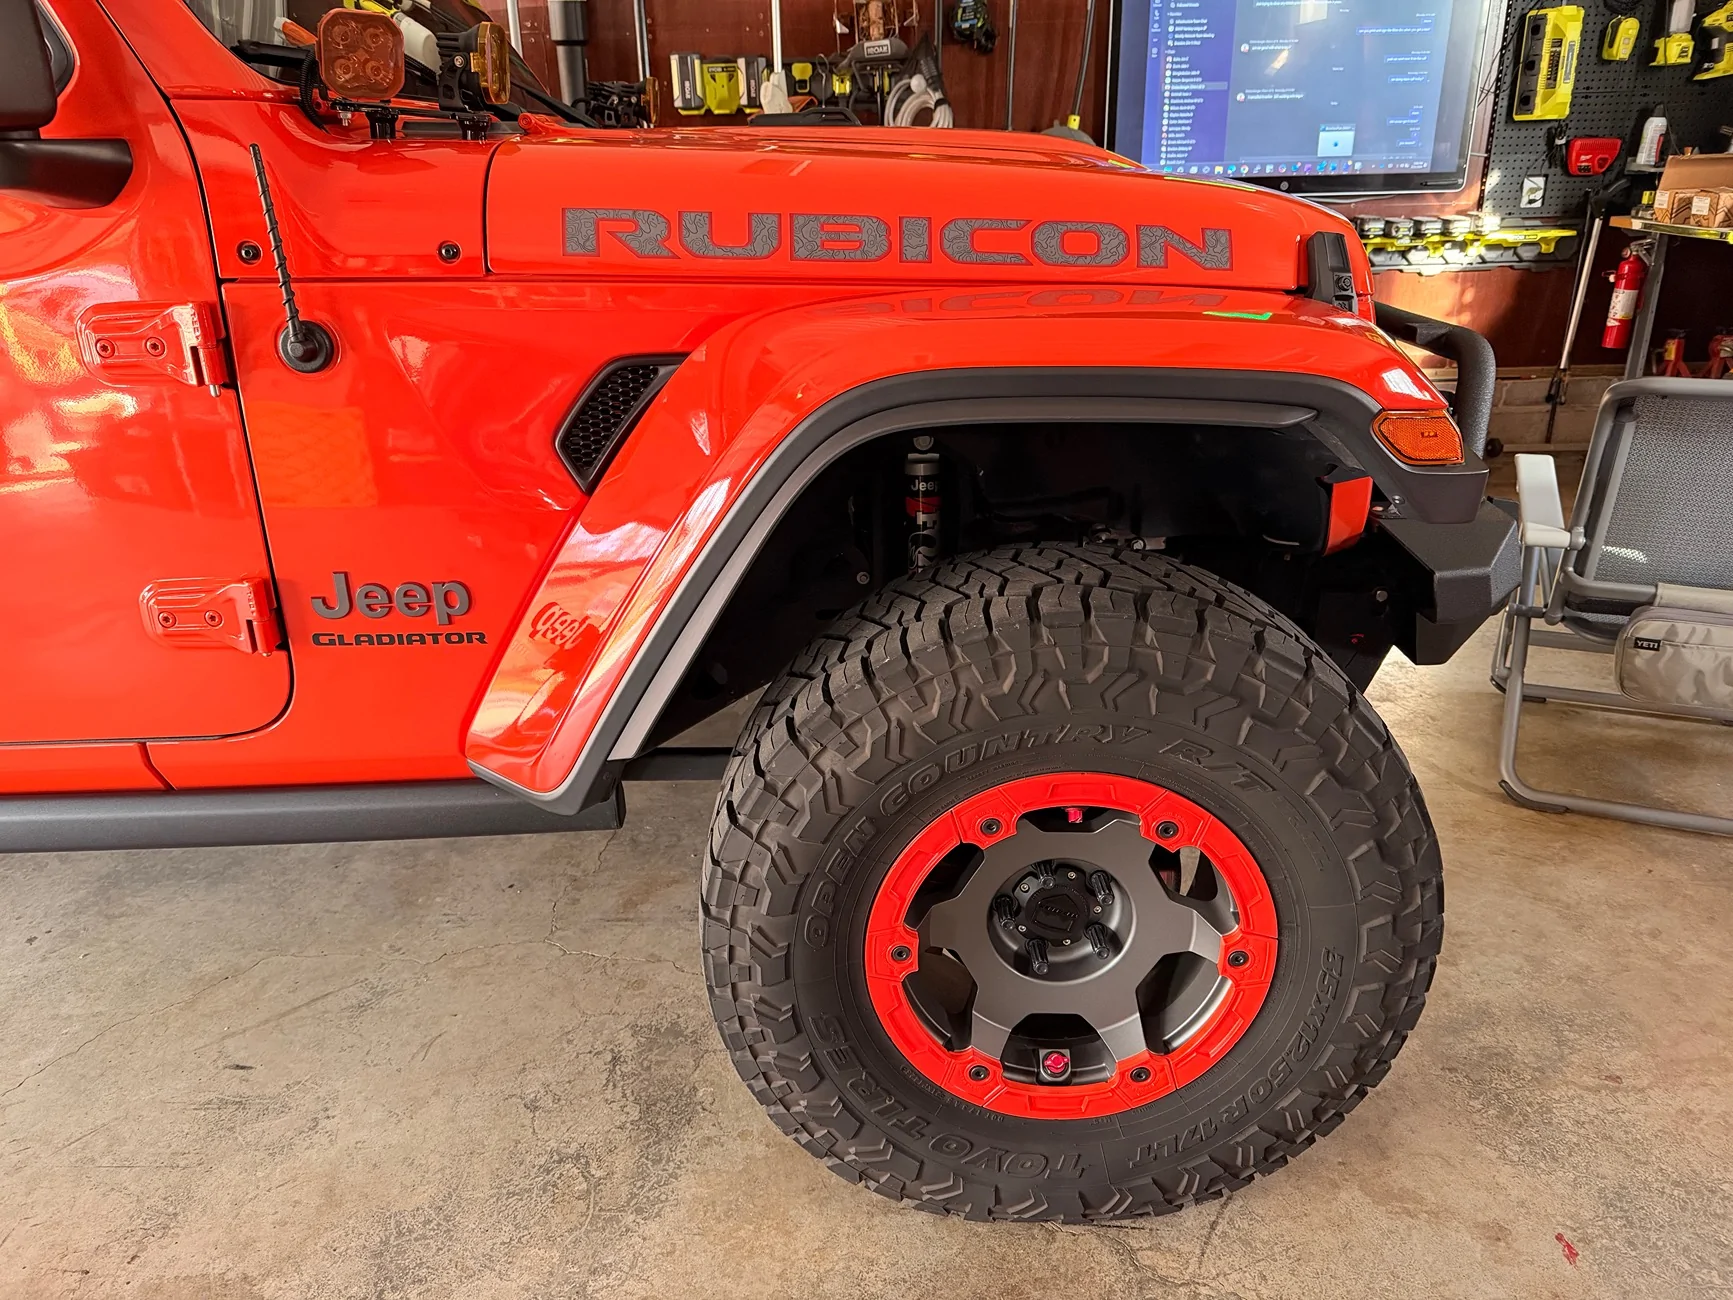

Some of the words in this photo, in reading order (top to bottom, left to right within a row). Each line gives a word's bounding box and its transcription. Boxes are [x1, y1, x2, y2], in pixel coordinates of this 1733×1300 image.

[562, 207, 1233, 271] RUBICON
[311, 571, 472, 625] Jeep
[312, 632, 489, 647] GLADIATOR
[1636, 640, 1659, 649] YETI
[804, 815, 878, 949] OPEN
[880, 723, 1152, 817] COUNTRY
[813, 1014, 933, 1141] TIRES
[928, 1134, 1090, 1180] TOYO
